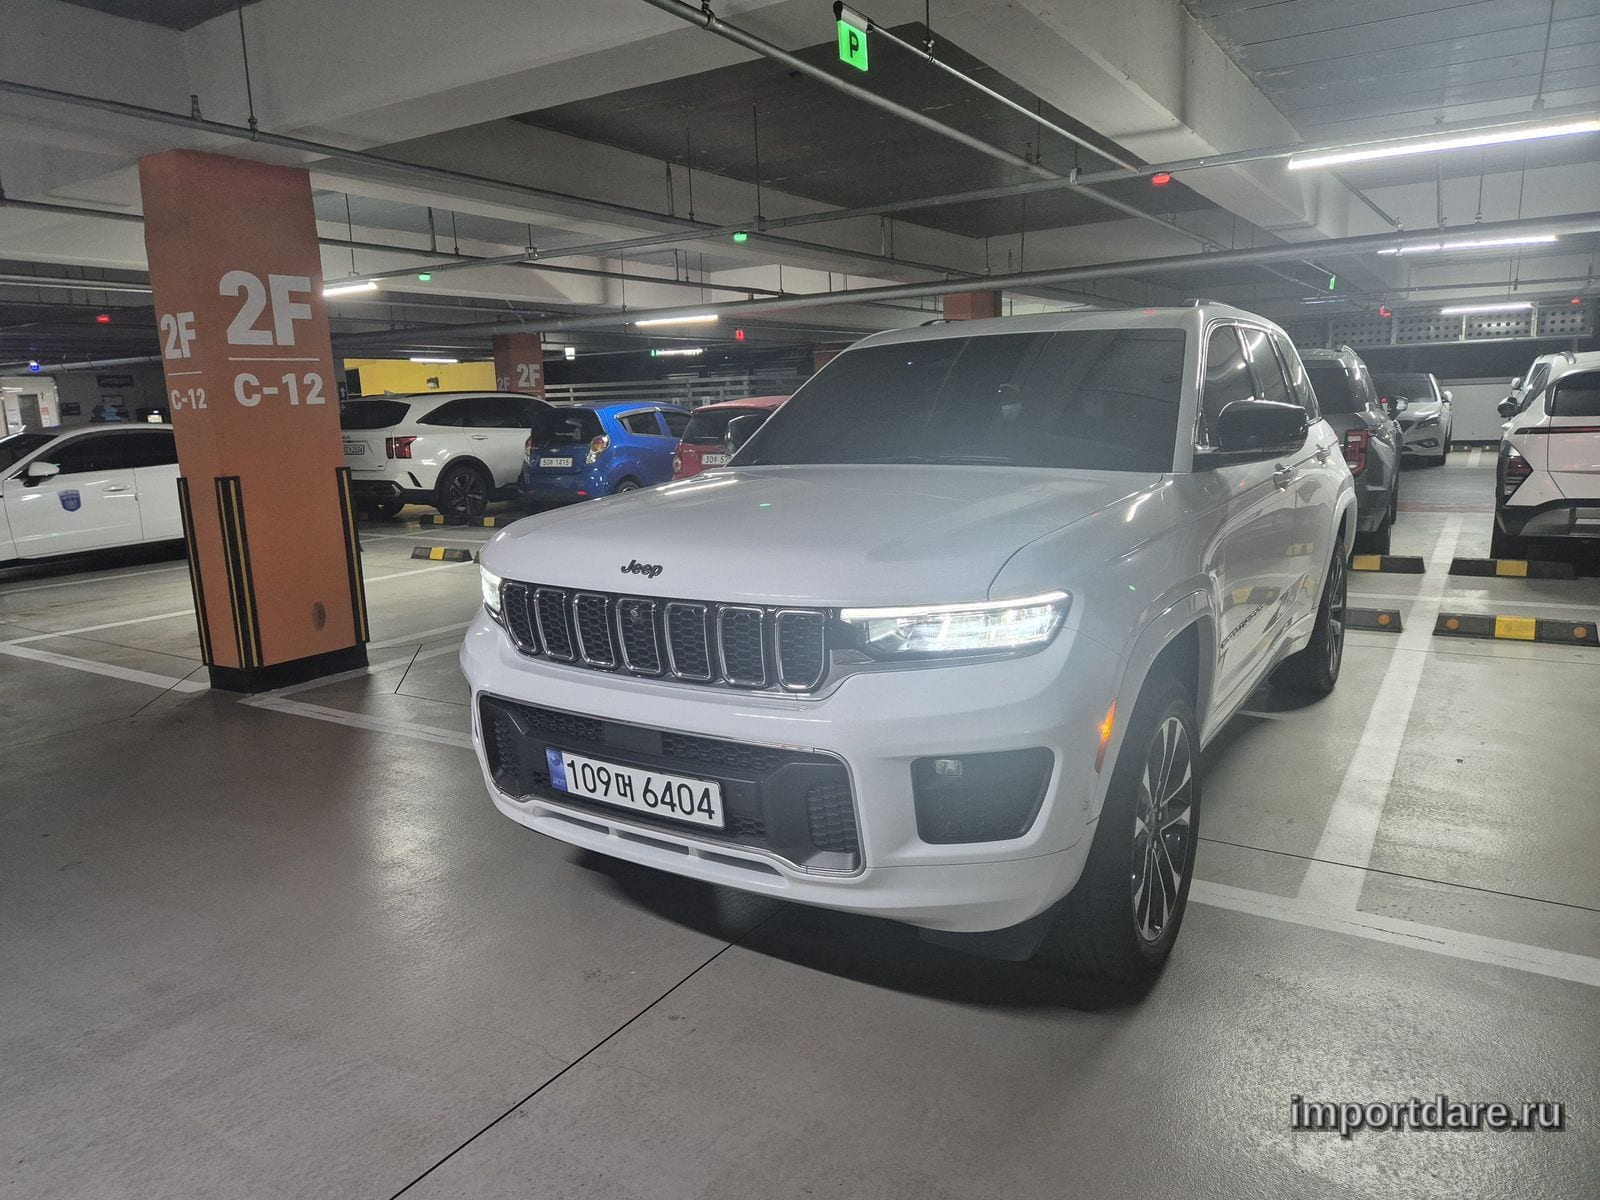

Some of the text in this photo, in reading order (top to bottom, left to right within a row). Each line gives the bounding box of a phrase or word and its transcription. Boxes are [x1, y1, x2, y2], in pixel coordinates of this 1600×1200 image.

[848, 29, 860, 59] P
[219, 270, 313, 346] 2F
[160, 311, 196, 360] 2F
[496, 376, 511, 392] 2F
[516, 363, 541, 388] 2F
[171, 388, 207, 410] C-12
[234, 372, 326, 407] C-12
[556, 458, 570, 466] 1415
[620, 559, 664, 579] Jeep
[567, 759, 716, 820] 109머 6404
